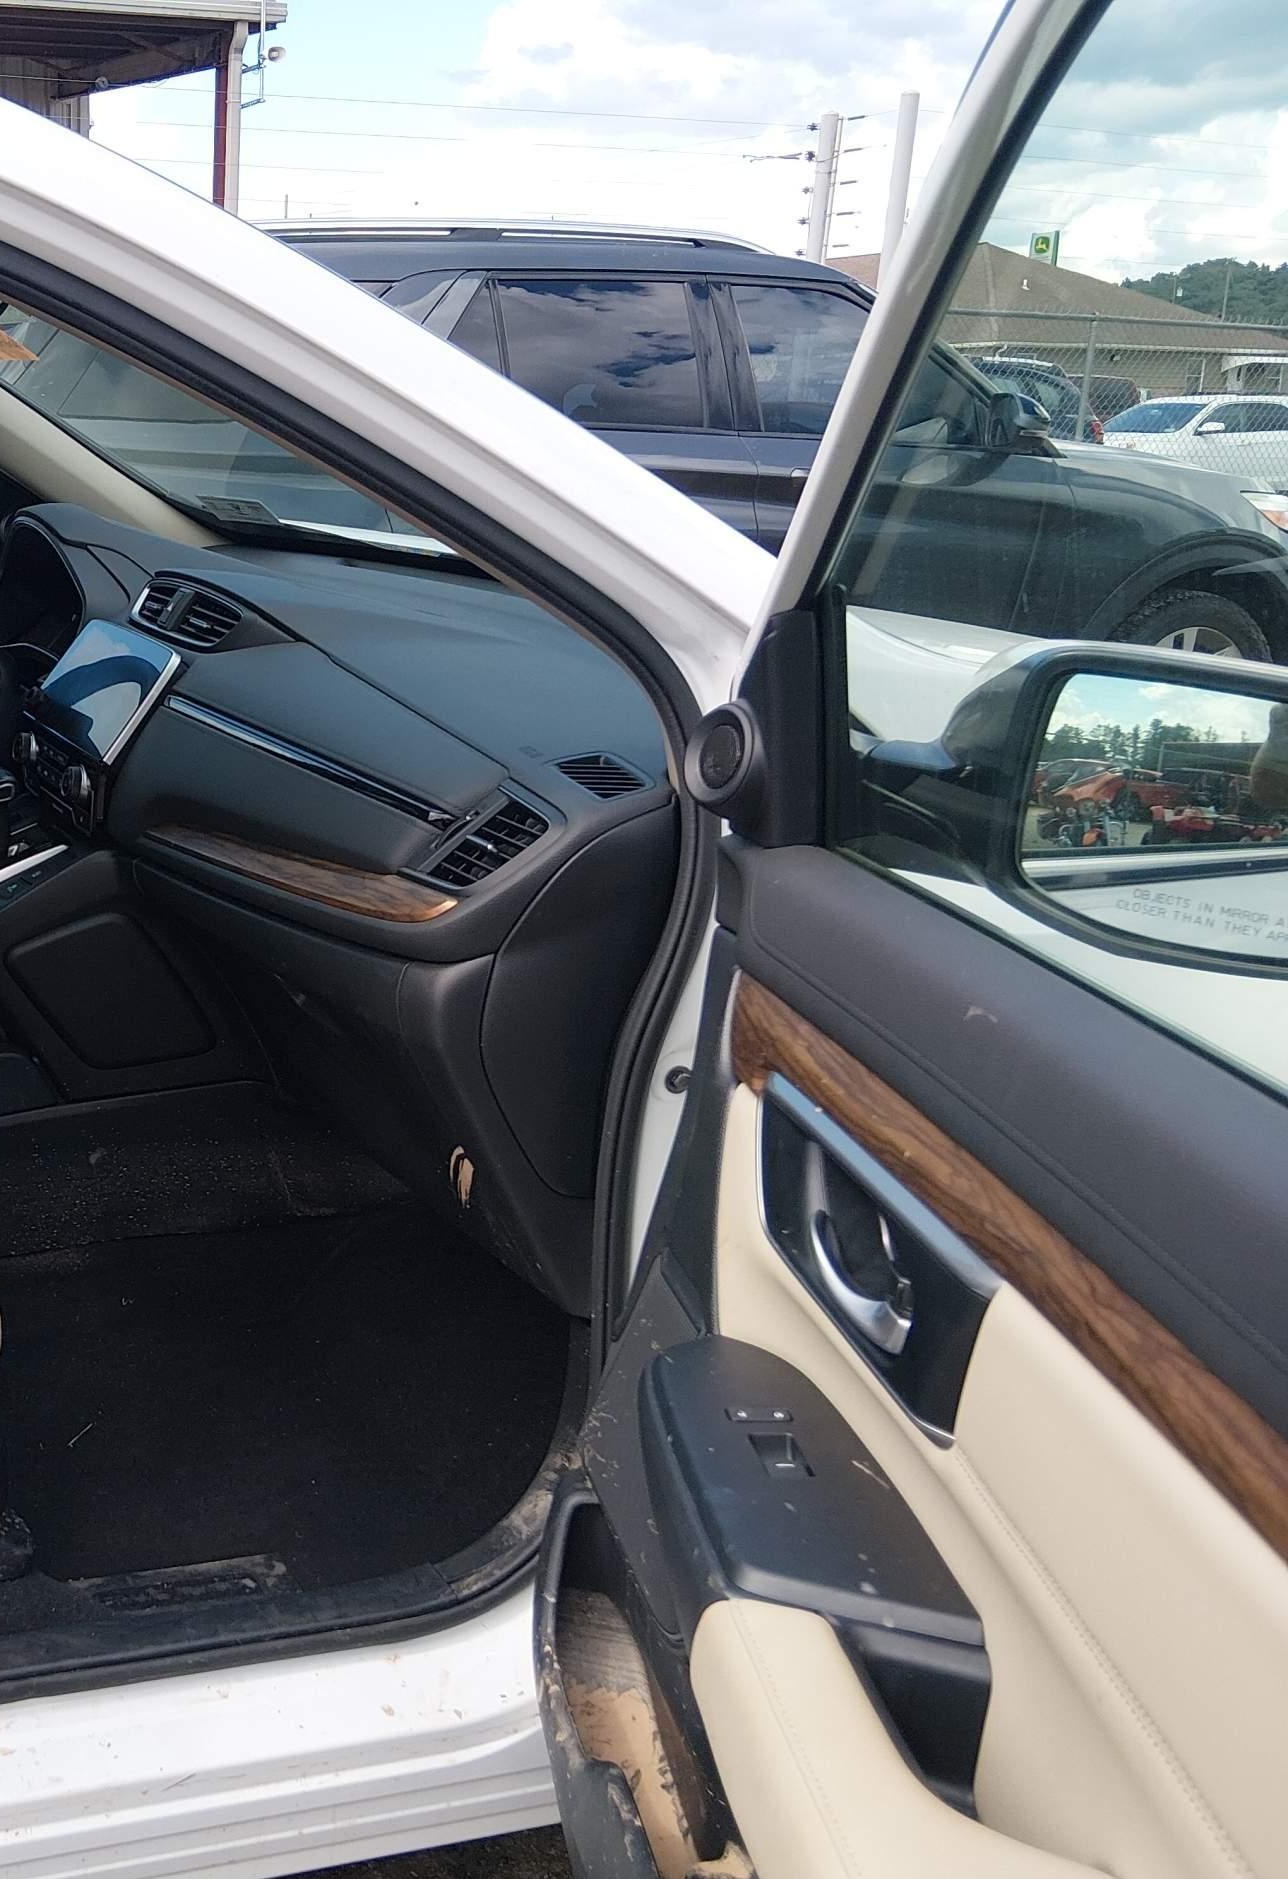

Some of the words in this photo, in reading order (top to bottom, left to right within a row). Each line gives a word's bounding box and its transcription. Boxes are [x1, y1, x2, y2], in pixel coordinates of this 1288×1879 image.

[1115, 899, 1167, 919] CLOSER
[1173, 910, 1215, 929] THAN
[1225, 921, 1262, 937] THEY
[1132, 888, 1191, 909] OBJECTS
[1198, 902, 1214, 914] IN
[1220, 905, 1269, 925] MIRROR
[1275, 916, 1288, 929] A
